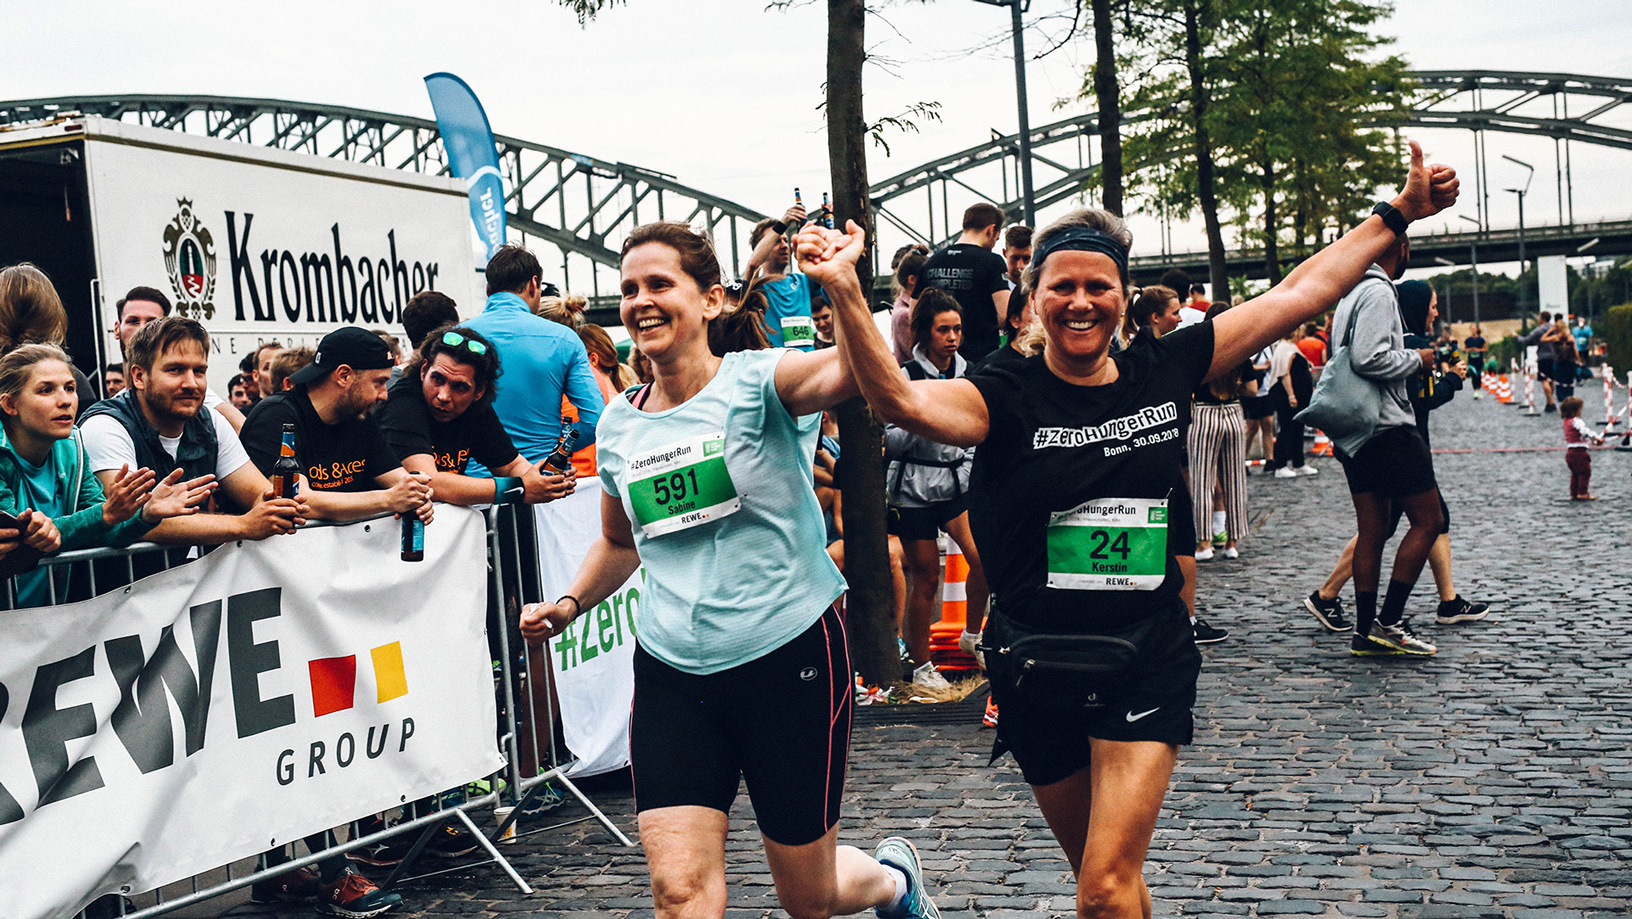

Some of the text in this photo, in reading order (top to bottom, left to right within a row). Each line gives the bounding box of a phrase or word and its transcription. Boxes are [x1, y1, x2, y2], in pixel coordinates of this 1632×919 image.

[224, 210, 439, 324] Krombacher
[792, 325, 810, 337] 646
[1103, 427, 1180, 457] Bonn, 30.09.2018
[630, 446, 692, 470] #ZeroHungerRun
[653, 467, 699, 505] 591
[668, 501, 696, 515] Sabine
[681, 512, 702, 524] REWE
[1089, 529, 1131, 560] 24
[1092, 562, 1128, 573] Kerstin
[1105, 577, 1130, 586] REWE
[276, 717, 415, 786] GROUP
